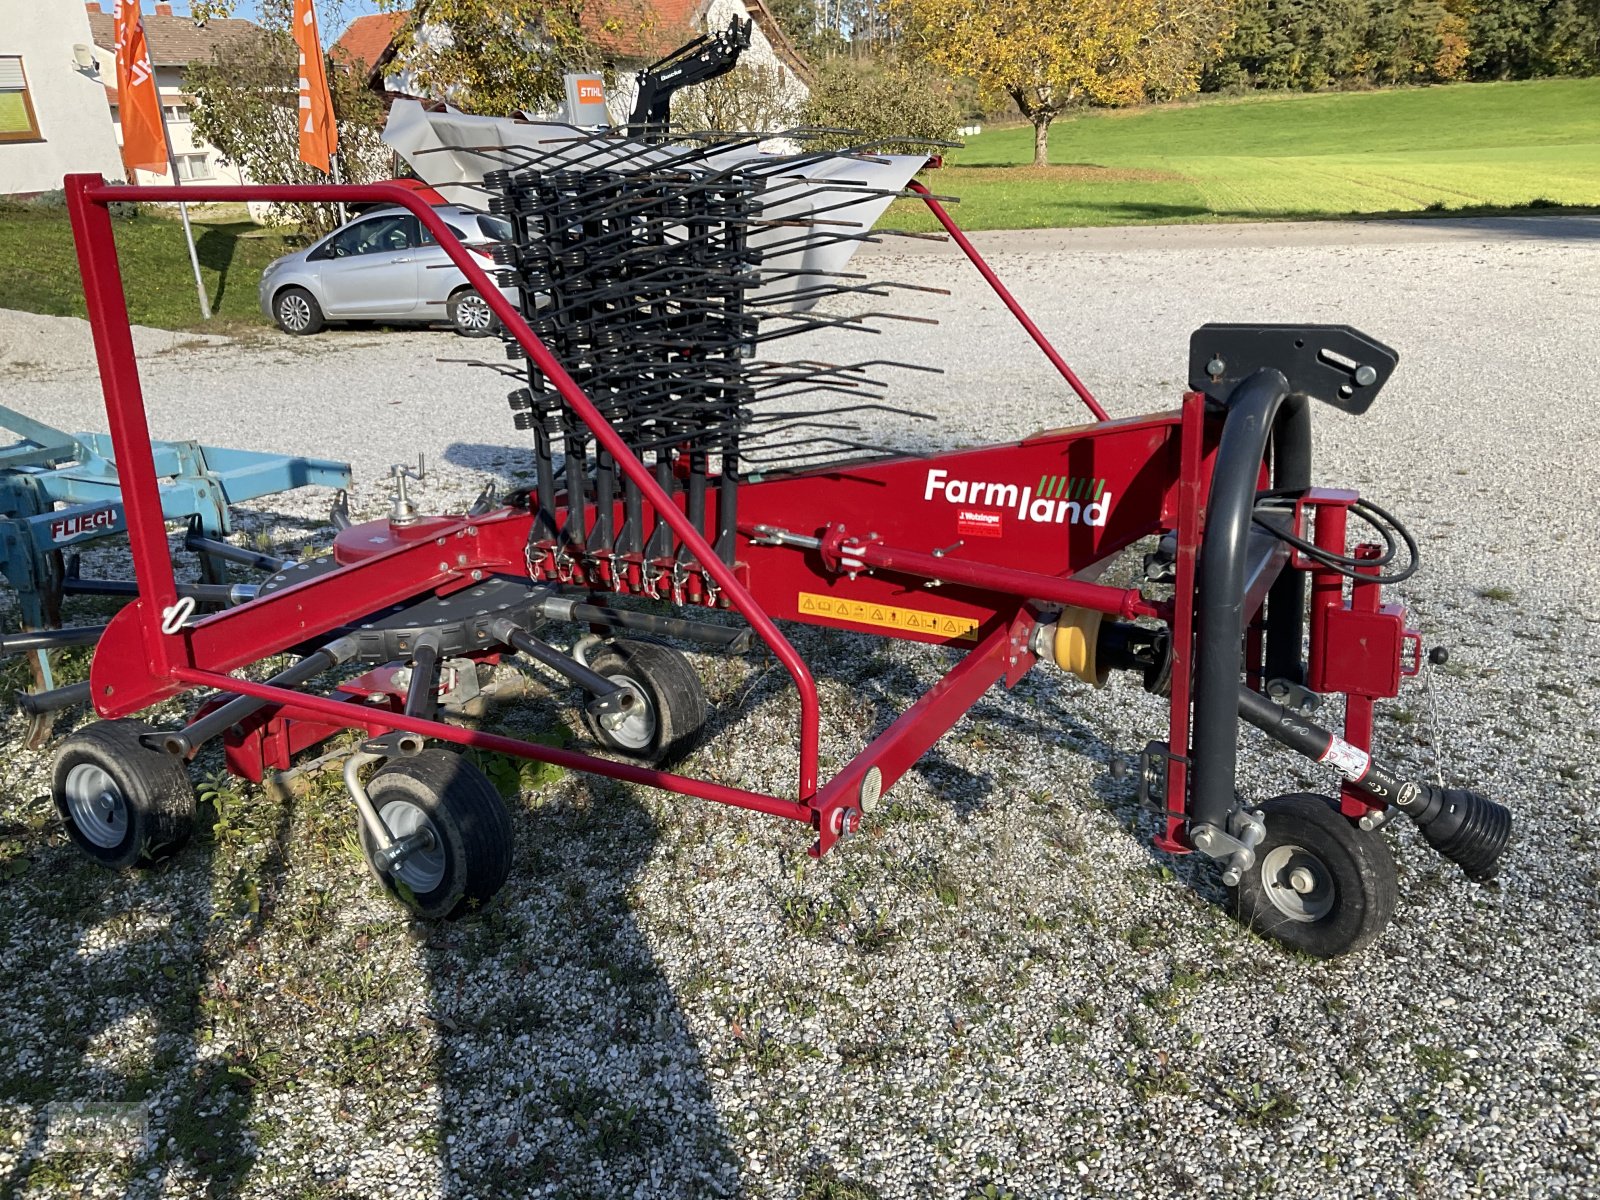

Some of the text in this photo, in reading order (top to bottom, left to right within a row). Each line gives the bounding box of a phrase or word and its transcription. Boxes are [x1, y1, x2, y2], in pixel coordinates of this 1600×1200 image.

[580, 87, 602, 97] STIHL
[924, 468, 1112, 528] Farmland
[51, 508, 117, 539] FLIEGL
[1372, 784, 1388, 796] CE
